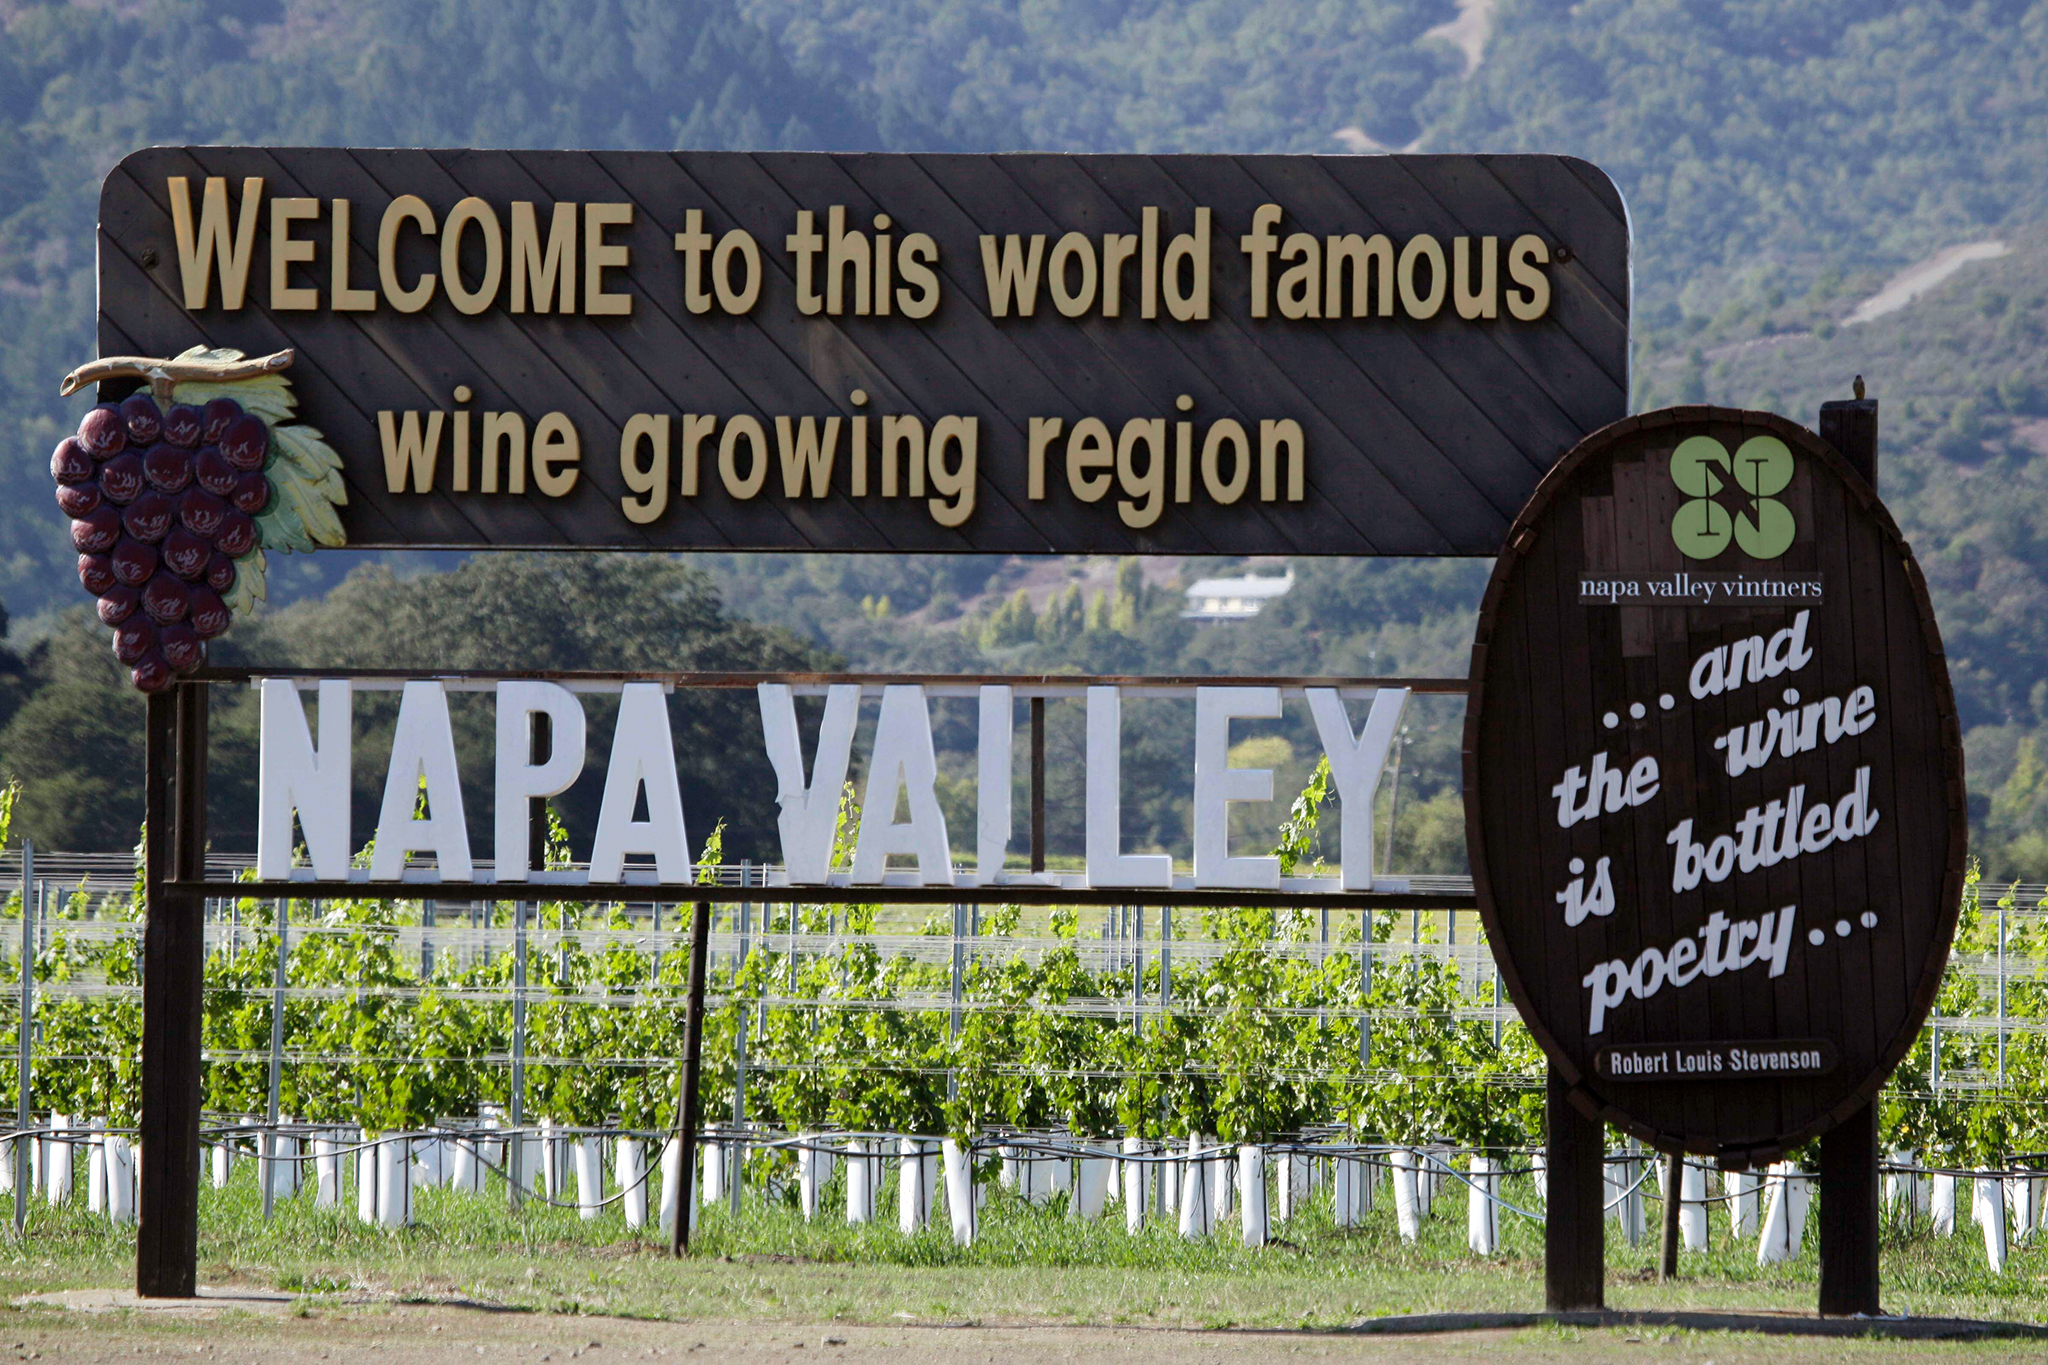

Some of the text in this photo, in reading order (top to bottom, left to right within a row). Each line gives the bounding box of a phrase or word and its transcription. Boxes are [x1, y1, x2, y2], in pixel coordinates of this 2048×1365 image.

[166, 176, 1552, 322] WELCOME to this world famous
[378, 385, 1306, 529] wine growing region
[1580, 572, 1823, 604] napa valley vintners
[257, 678, 693, 885] NAPA
[1552, 685, 1877, 829] the wine
[1556, 765, 1880, 928] is bottled
[1611, 1047, 1822, 1075] Robert Louis Stevenson
